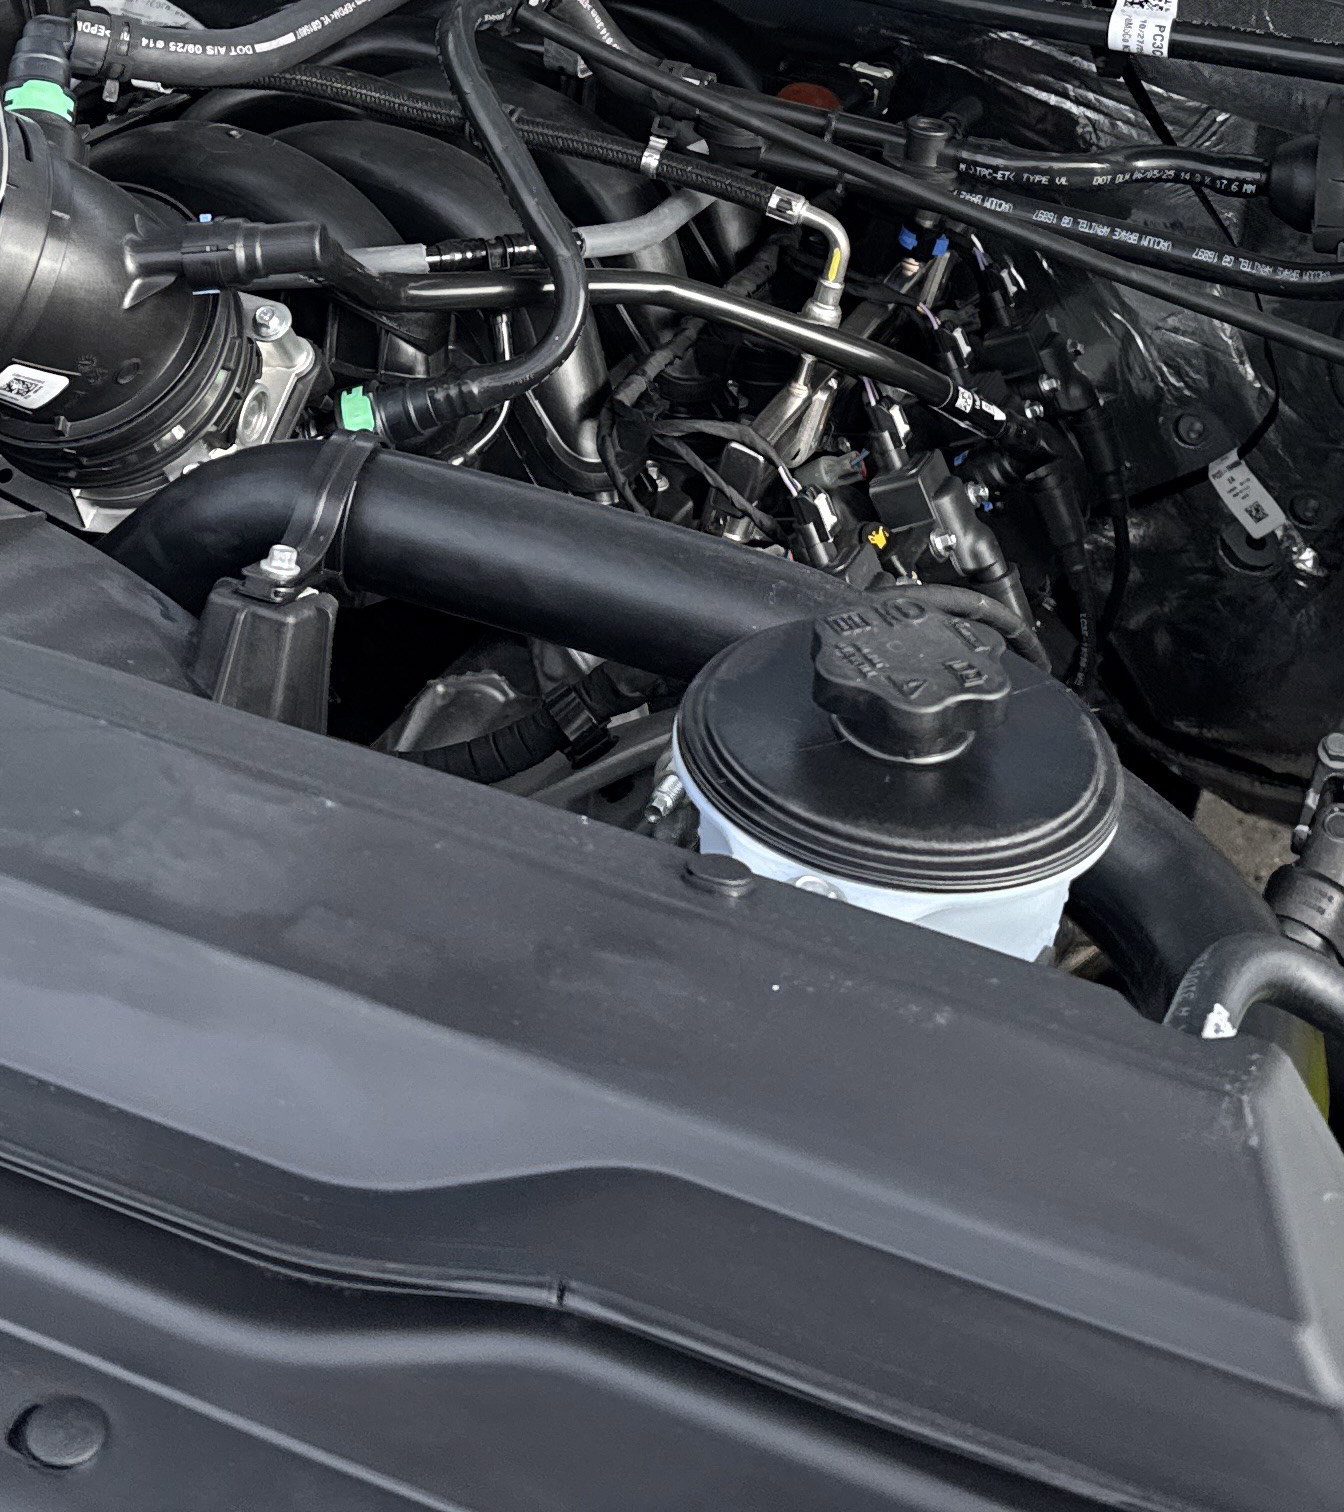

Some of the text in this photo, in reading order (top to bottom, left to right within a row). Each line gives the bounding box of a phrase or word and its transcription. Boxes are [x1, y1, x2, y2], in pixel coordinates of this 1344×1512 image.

[206, 46, 226, 59] AIS
[230, 45, 253, 55] DOT
[1022, 173, 1050, 184] TYPE
[1092, 175, 1112, 186] DOT
